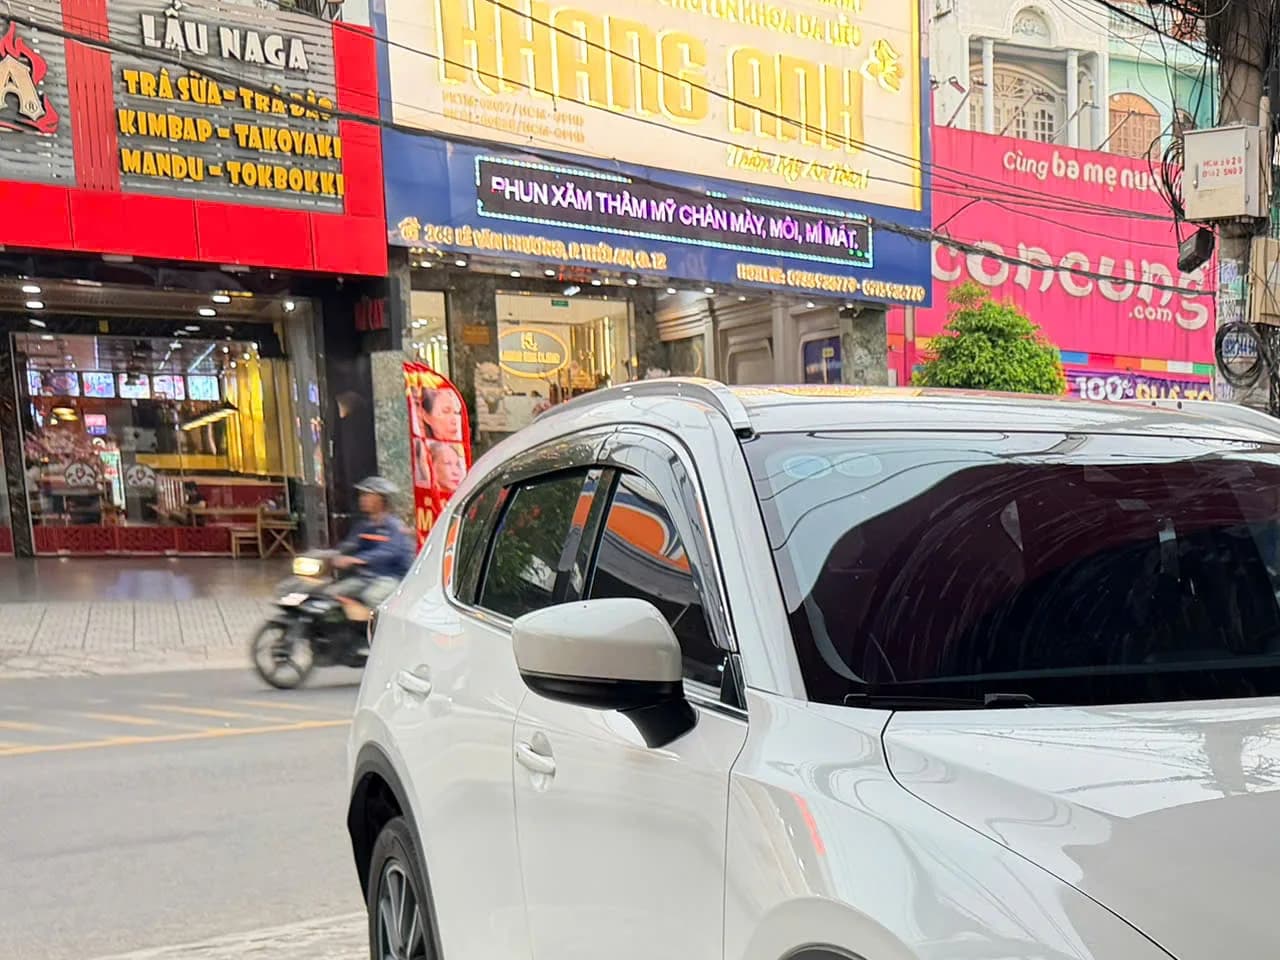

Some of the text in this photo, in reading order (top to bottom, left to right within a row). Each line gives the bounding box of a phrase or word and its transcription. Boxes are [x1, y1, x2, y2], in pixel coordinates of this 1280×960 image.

[218, 25, 309, 71] NAGA
[434, 0, 712, 126] KHANG
[729, 47, 867, 154] ANH
[118, 109, 213, 144] KIMBAP
[234, 123, 342, 159] TAKOYAKI
[121, 148, 204, 182] MANDU
[226, 161, 345, 196] TOKBOKKI
[1003, 150, 1049, 180] Cùng
[1051, 151, 1080, 180] ba
[1083, 163, 1118, 192] mẹ
[491, 175, 548, 206] PHUN
[551, 182, 593, 212] XĂM
[650, 198, 677, 222] MỸ
[679, 203, 727, 231] CHÂN
[730, 208, 766, 239] MÀY,
[769, 216, 803, 243] MÔI,
[805, 219, 823, 244] MÍ
[931, 240, 1208, 330] concung
[1128, 304, 1173, 322] .com
